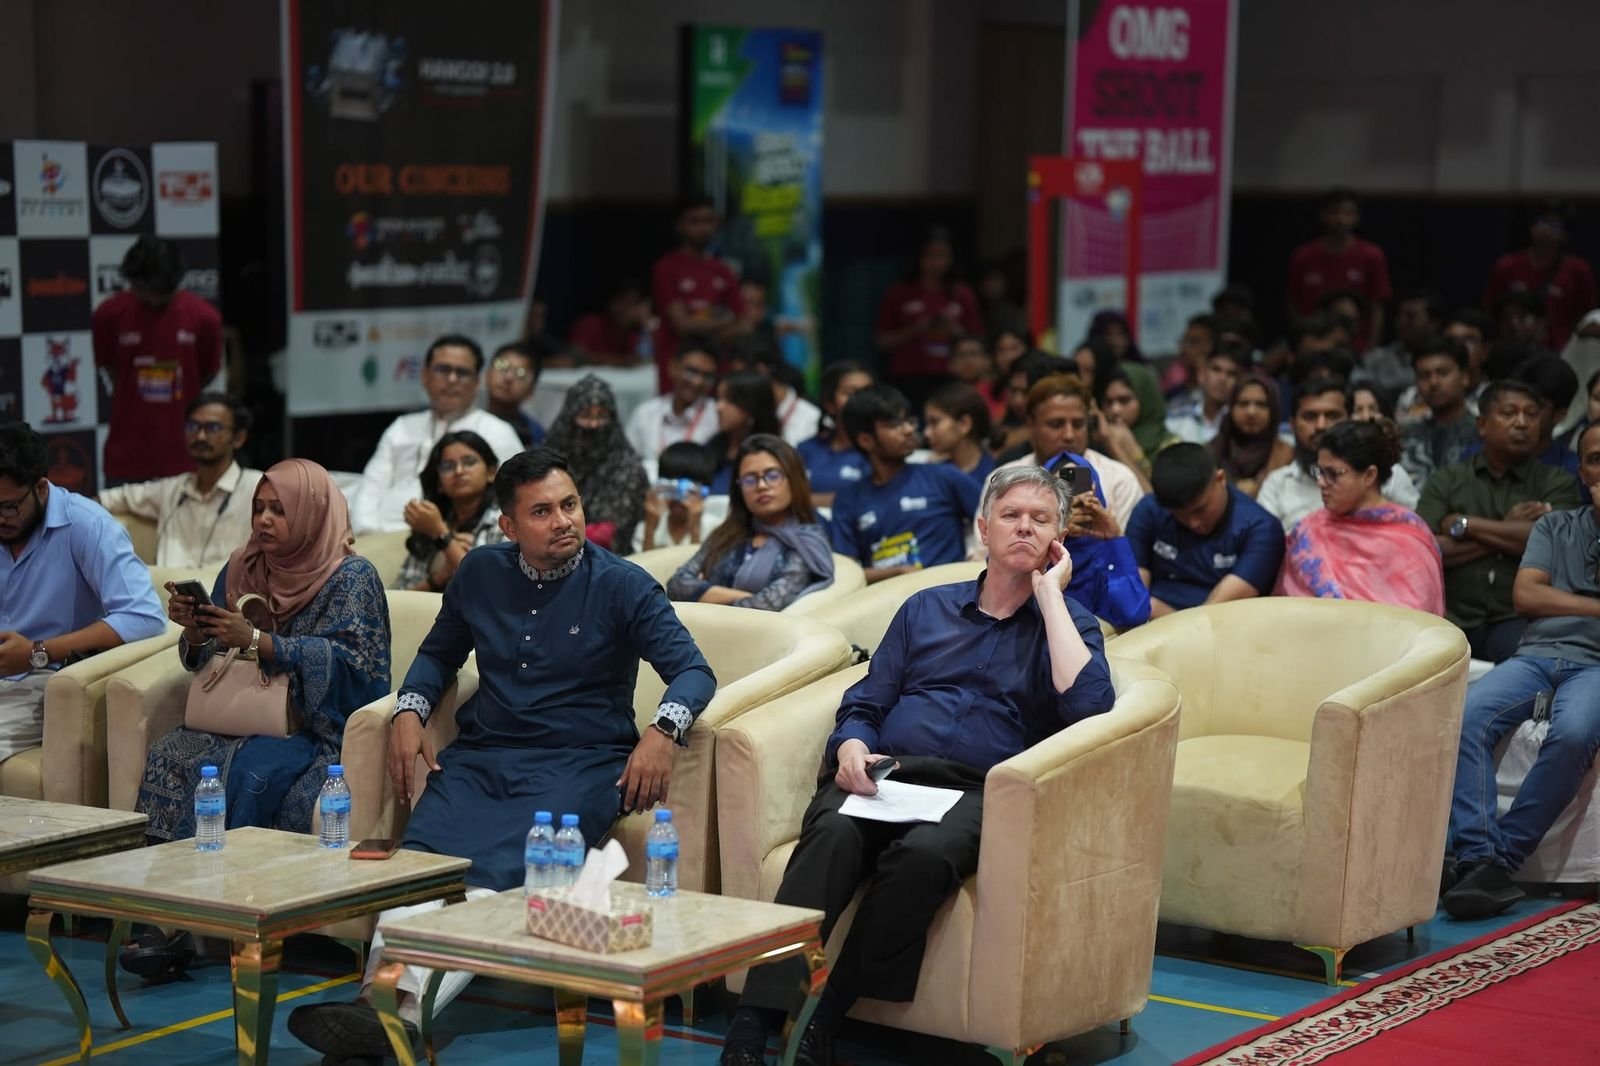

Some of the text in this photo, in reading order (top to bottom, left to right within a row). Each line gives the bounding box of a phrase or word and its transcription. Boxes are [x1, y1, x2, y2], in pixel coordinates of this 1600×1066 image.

[1109, 6, 1190, 61] OMG
[1094, 69, 1205, 118] SHOOT
[1144, 127, 1215, 175] BALL
